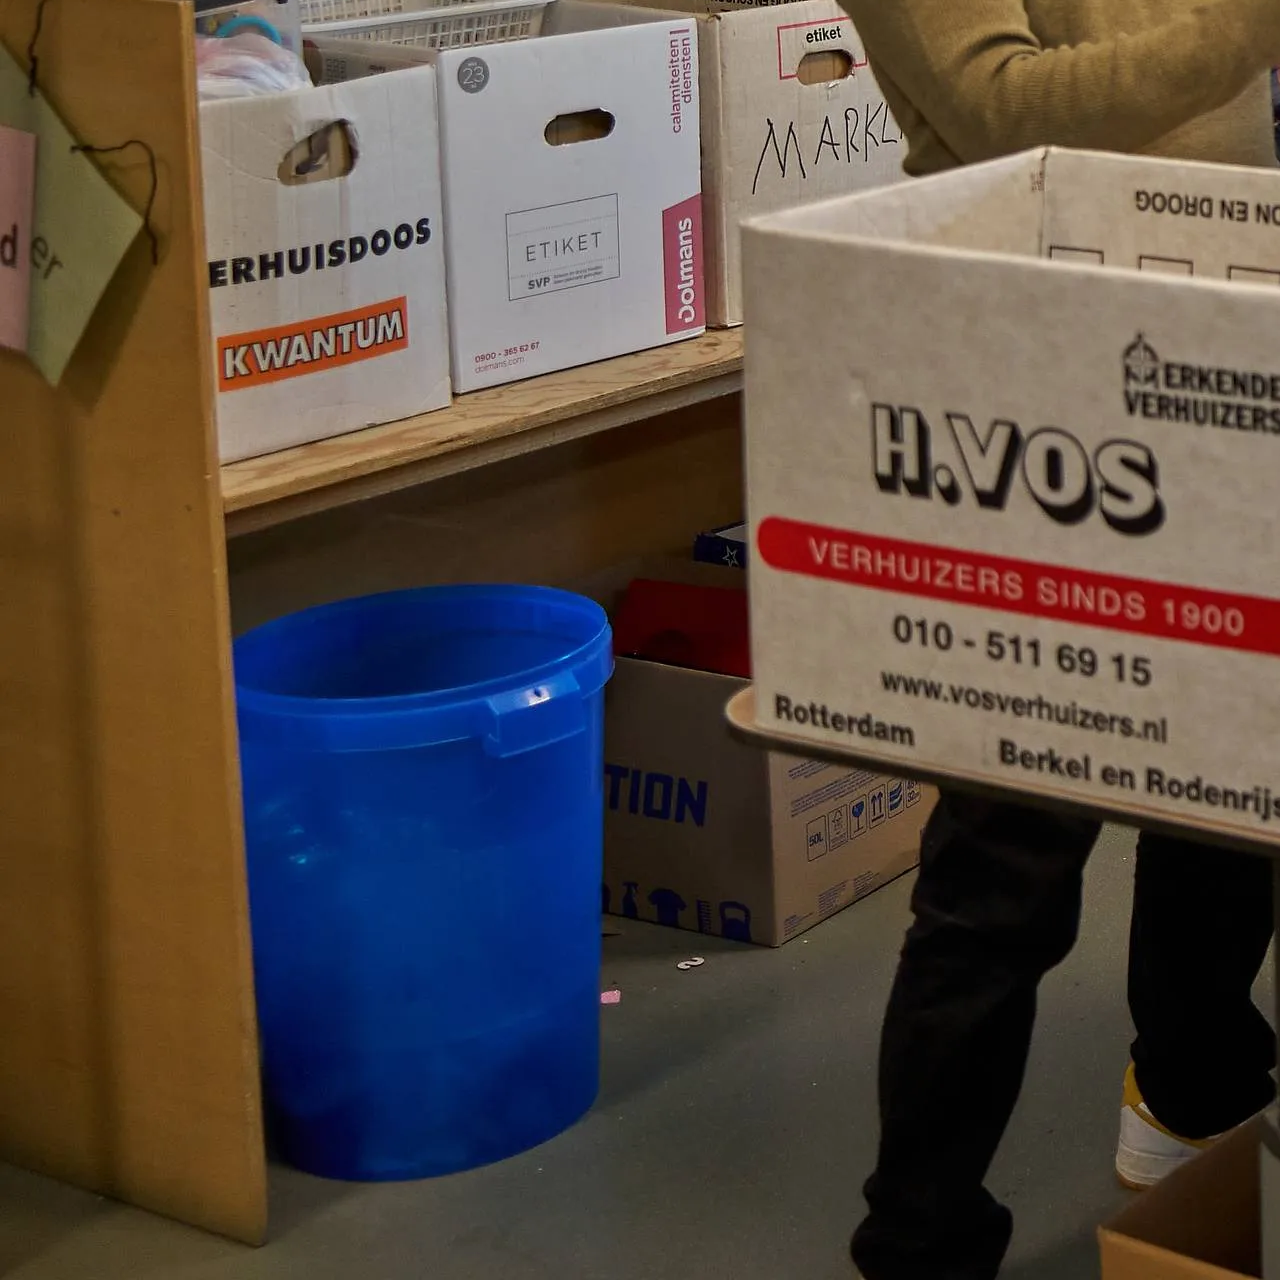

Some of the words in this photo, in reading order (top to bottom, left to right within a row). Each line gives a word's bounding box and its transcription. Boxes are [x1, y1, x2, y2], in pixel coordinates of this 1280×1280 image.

[806, 25, 842, 43] etiket
[462, 67, 484, 85] 23
[669, 38, 681, 134] calamiteiten
[681, 37, 693, 104] diensten
[752, 101, 904, 195] MARKL
[1135, 190, 1214, 219] DROOG
[1220, 199, 1248, 221] EN
[208, 217, 431, 289] ERHUISDOOS
[526, 231, 602, 262] ETIKET
[677, 217, 696, 324] Dolmans
[528, 275, 551, 291] SVP
[223, 308, 405, 381] KWANTUM
[475, 351, 496, 364] 0900
[504, 346, 518, 358] 365
[520, 343, 529, 355] 62
[475, 356, 525, 374] dolmans.com
[870, 402, 1166, 537] H.VOS
[808, 536, 1024, 600] VERHUIZERS
[1037, 579, 1146, 621] SINDS
[1162, 598, 1245, 637] 1900
[894, 615, 953, 653] 010
[987, 632, 1042, 668] 511
[1057, 644, 1099, 677] 69
[1112, 654, 1152, 687] 15
[775, 694, 916, 748] Rotterdam
[999, 739, 1091, 781] Berkel
[1102, 762, 1136, 790] en
[881, 670, 1168, 744] www.vosverhuizers.nl
